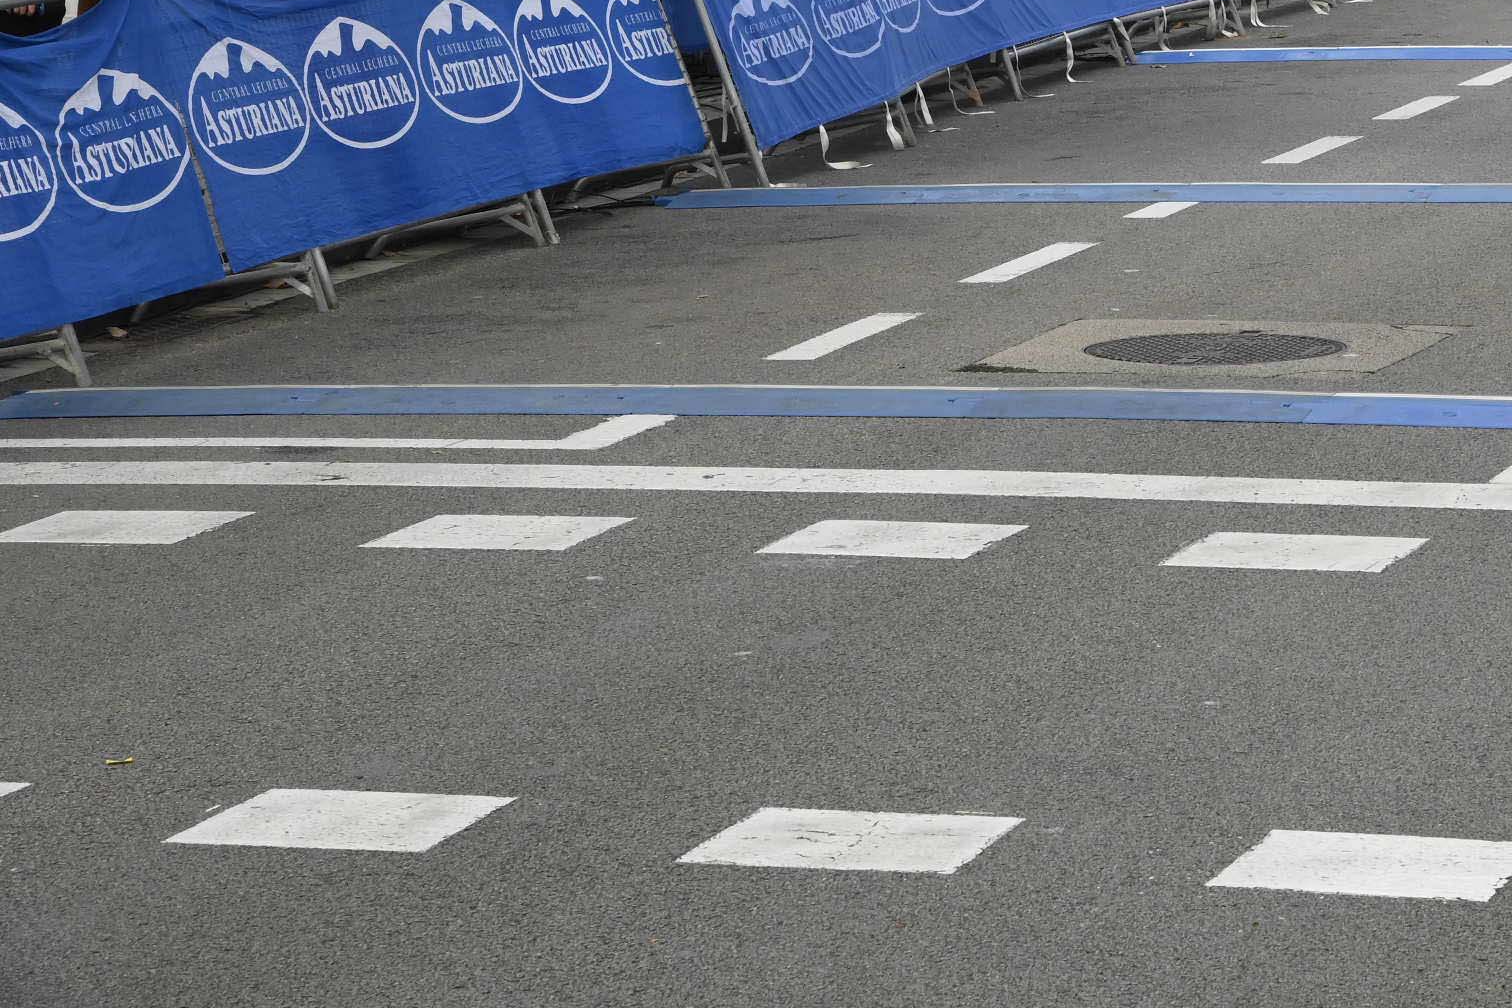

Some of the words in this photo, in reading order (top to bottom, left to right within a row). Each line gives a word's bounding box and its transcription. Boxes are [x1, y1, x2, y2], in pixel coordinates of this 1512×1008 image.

[530, 26, 560, 42] CENTRAL
[561, 21, 591, 37] LECHERA
[624, 10, 657, 25] CENTRAL
[436, 40, 470, 57] CENTRAL
[470, 36, 503, 52] LECHERA
[522, 33, 608, 80] ASTURIANA
[740, 24, 811, 69] ASTURIANA
[324, 63, 361, 80] CENTRAL
[362, 54, 399, 74] LECHERA
[427, 49, 519, 98] ASTURIANA
[211, 86, 251, 103] CENTRAL
[251, 77, 289, 95] LECHERA
[314, 72, 415, 123] ASTURIANA
[79, 118, 122, 137] CENTRAL
[200, 95, 305, 148] ASTURIANA
[68, 124, 182, 185] ASTURIANA
